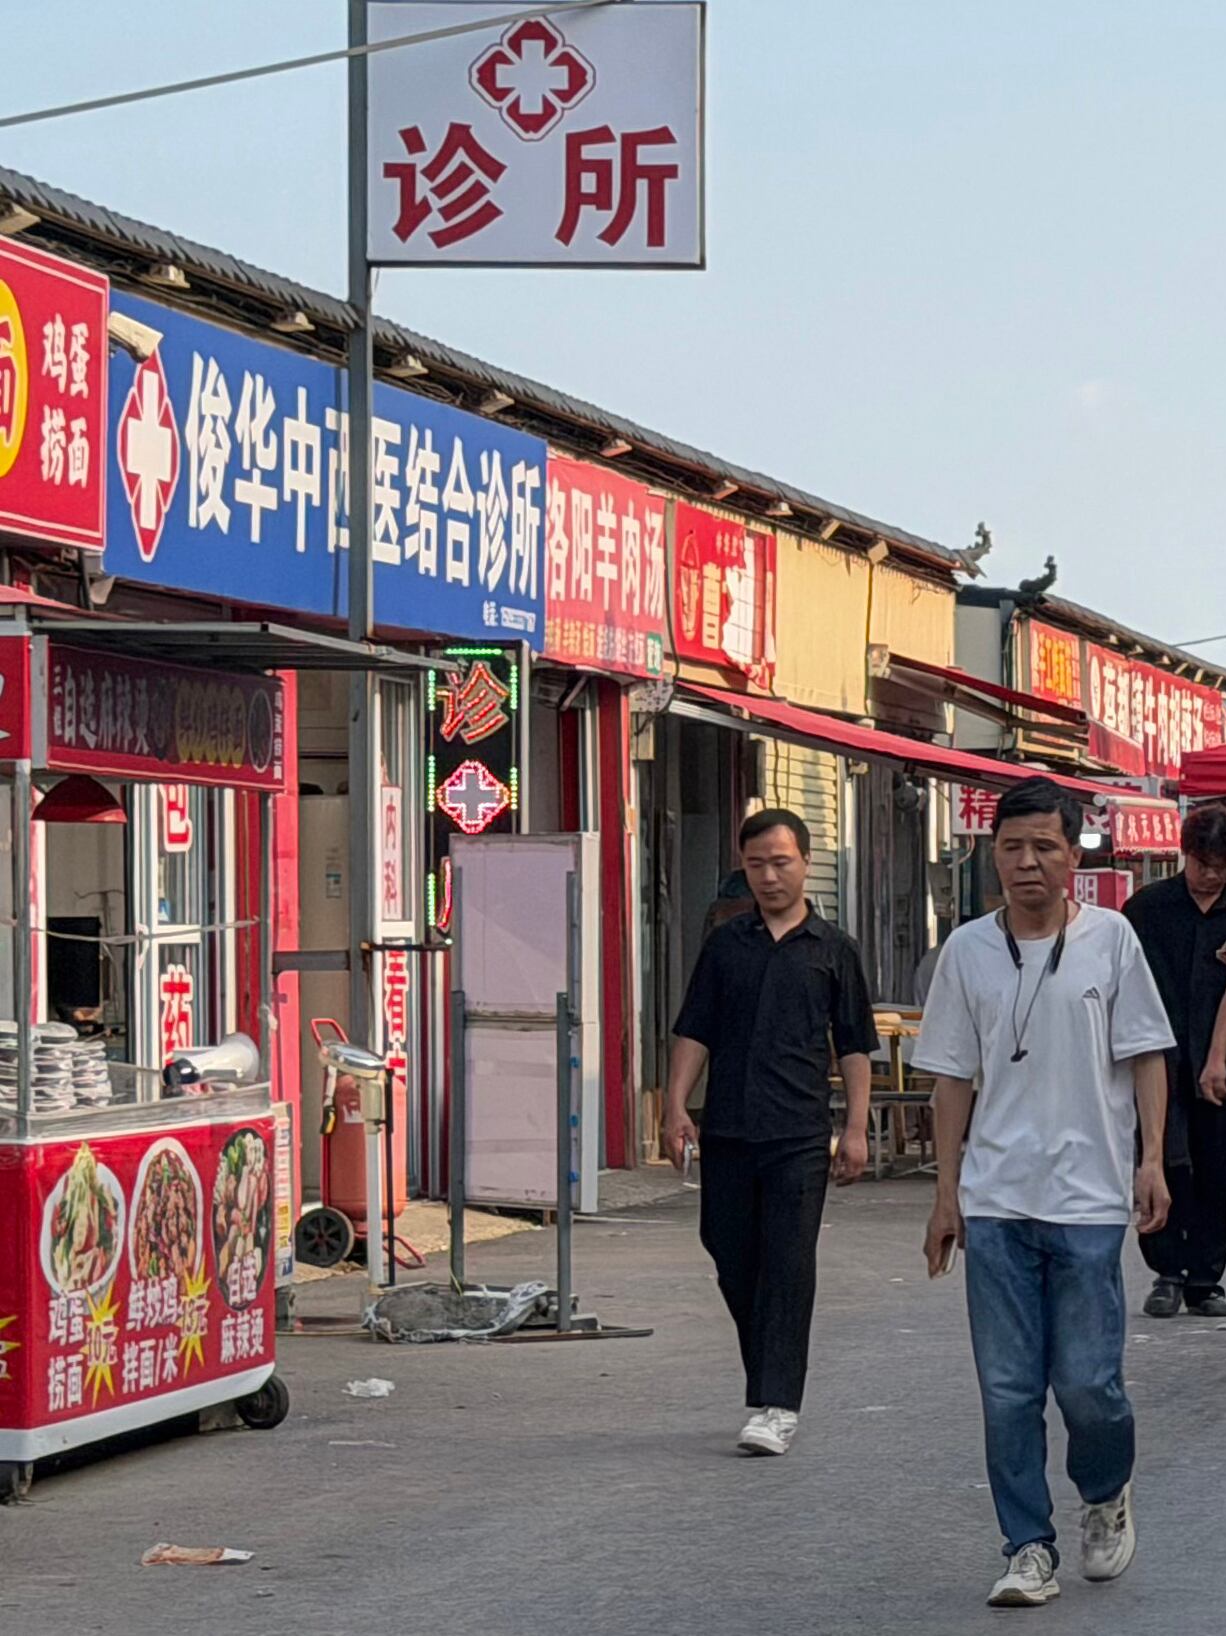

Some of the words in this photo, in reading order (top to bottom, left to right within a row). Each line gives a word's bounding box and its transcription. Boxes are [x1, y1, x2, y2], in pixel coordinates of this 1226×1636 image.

[383, 121, 679, 249] 诊所
[42, 312, 91, 399] 鸡蛋
[41, 404, 90, 488] 捞面
[185, 350, 541, 600] 俊华中西医结合诊所
[545, 476, 665, 621] 洛阳羊肉汤
[126, 1273, 178, 1332] 鲜炒鸡
[228, 1252, 258, 1306] 自选
[48, 1289, 86, 1348] 鸡蛋
[220, 1307, 265, 1365] 麻辣烫
[47, 1354, 84, 1413] 捞面
[121, 1331, 178, 1394] 拌面/米
